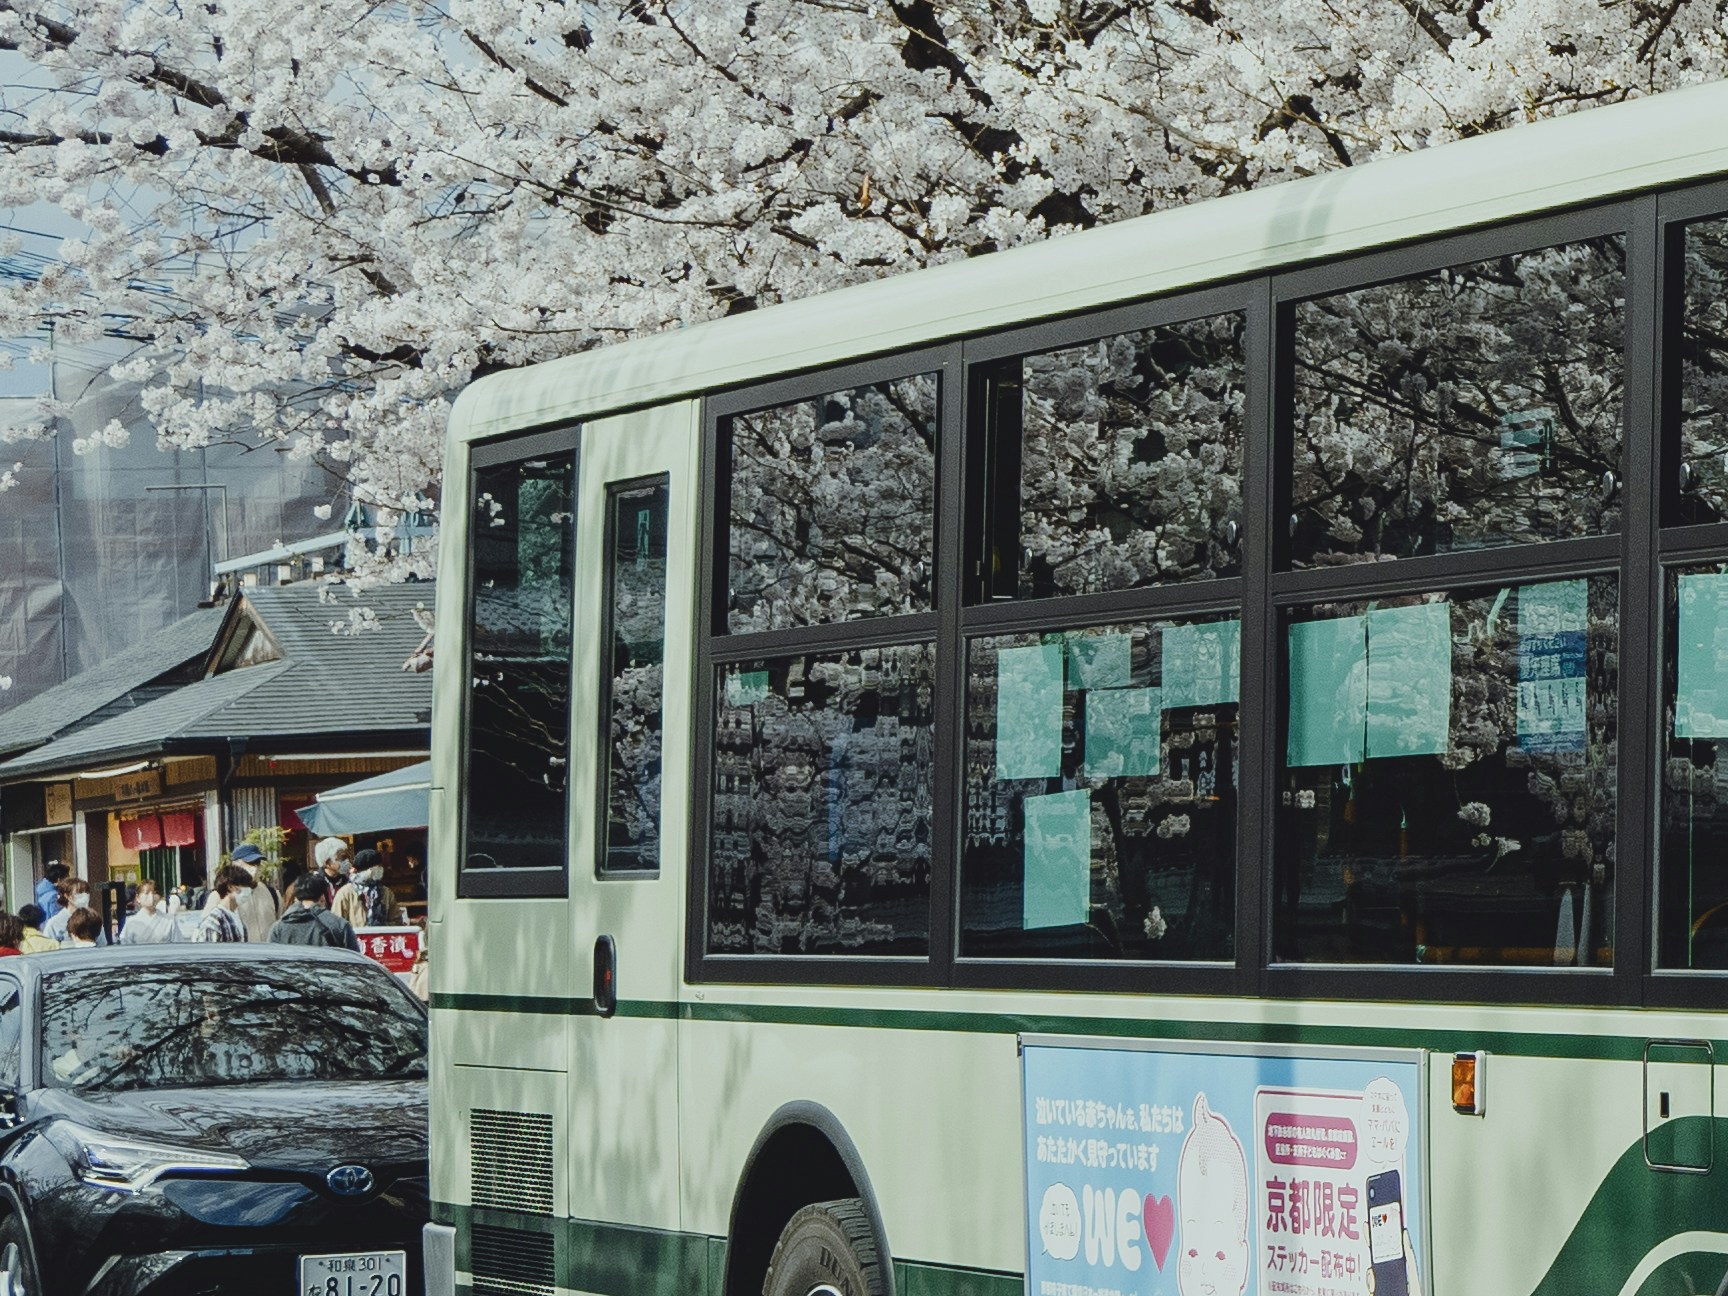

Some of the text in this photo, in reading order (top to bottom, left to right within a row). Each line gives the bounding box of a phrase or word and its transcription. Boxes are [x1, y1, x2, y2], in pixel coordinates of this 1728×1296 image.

[1036, 1135, 1160, 1172] あたたかく見守っています
[1082, 1183, 1142, 1272] WE
[1266, 1176, 1360, 1240] 京都限定
